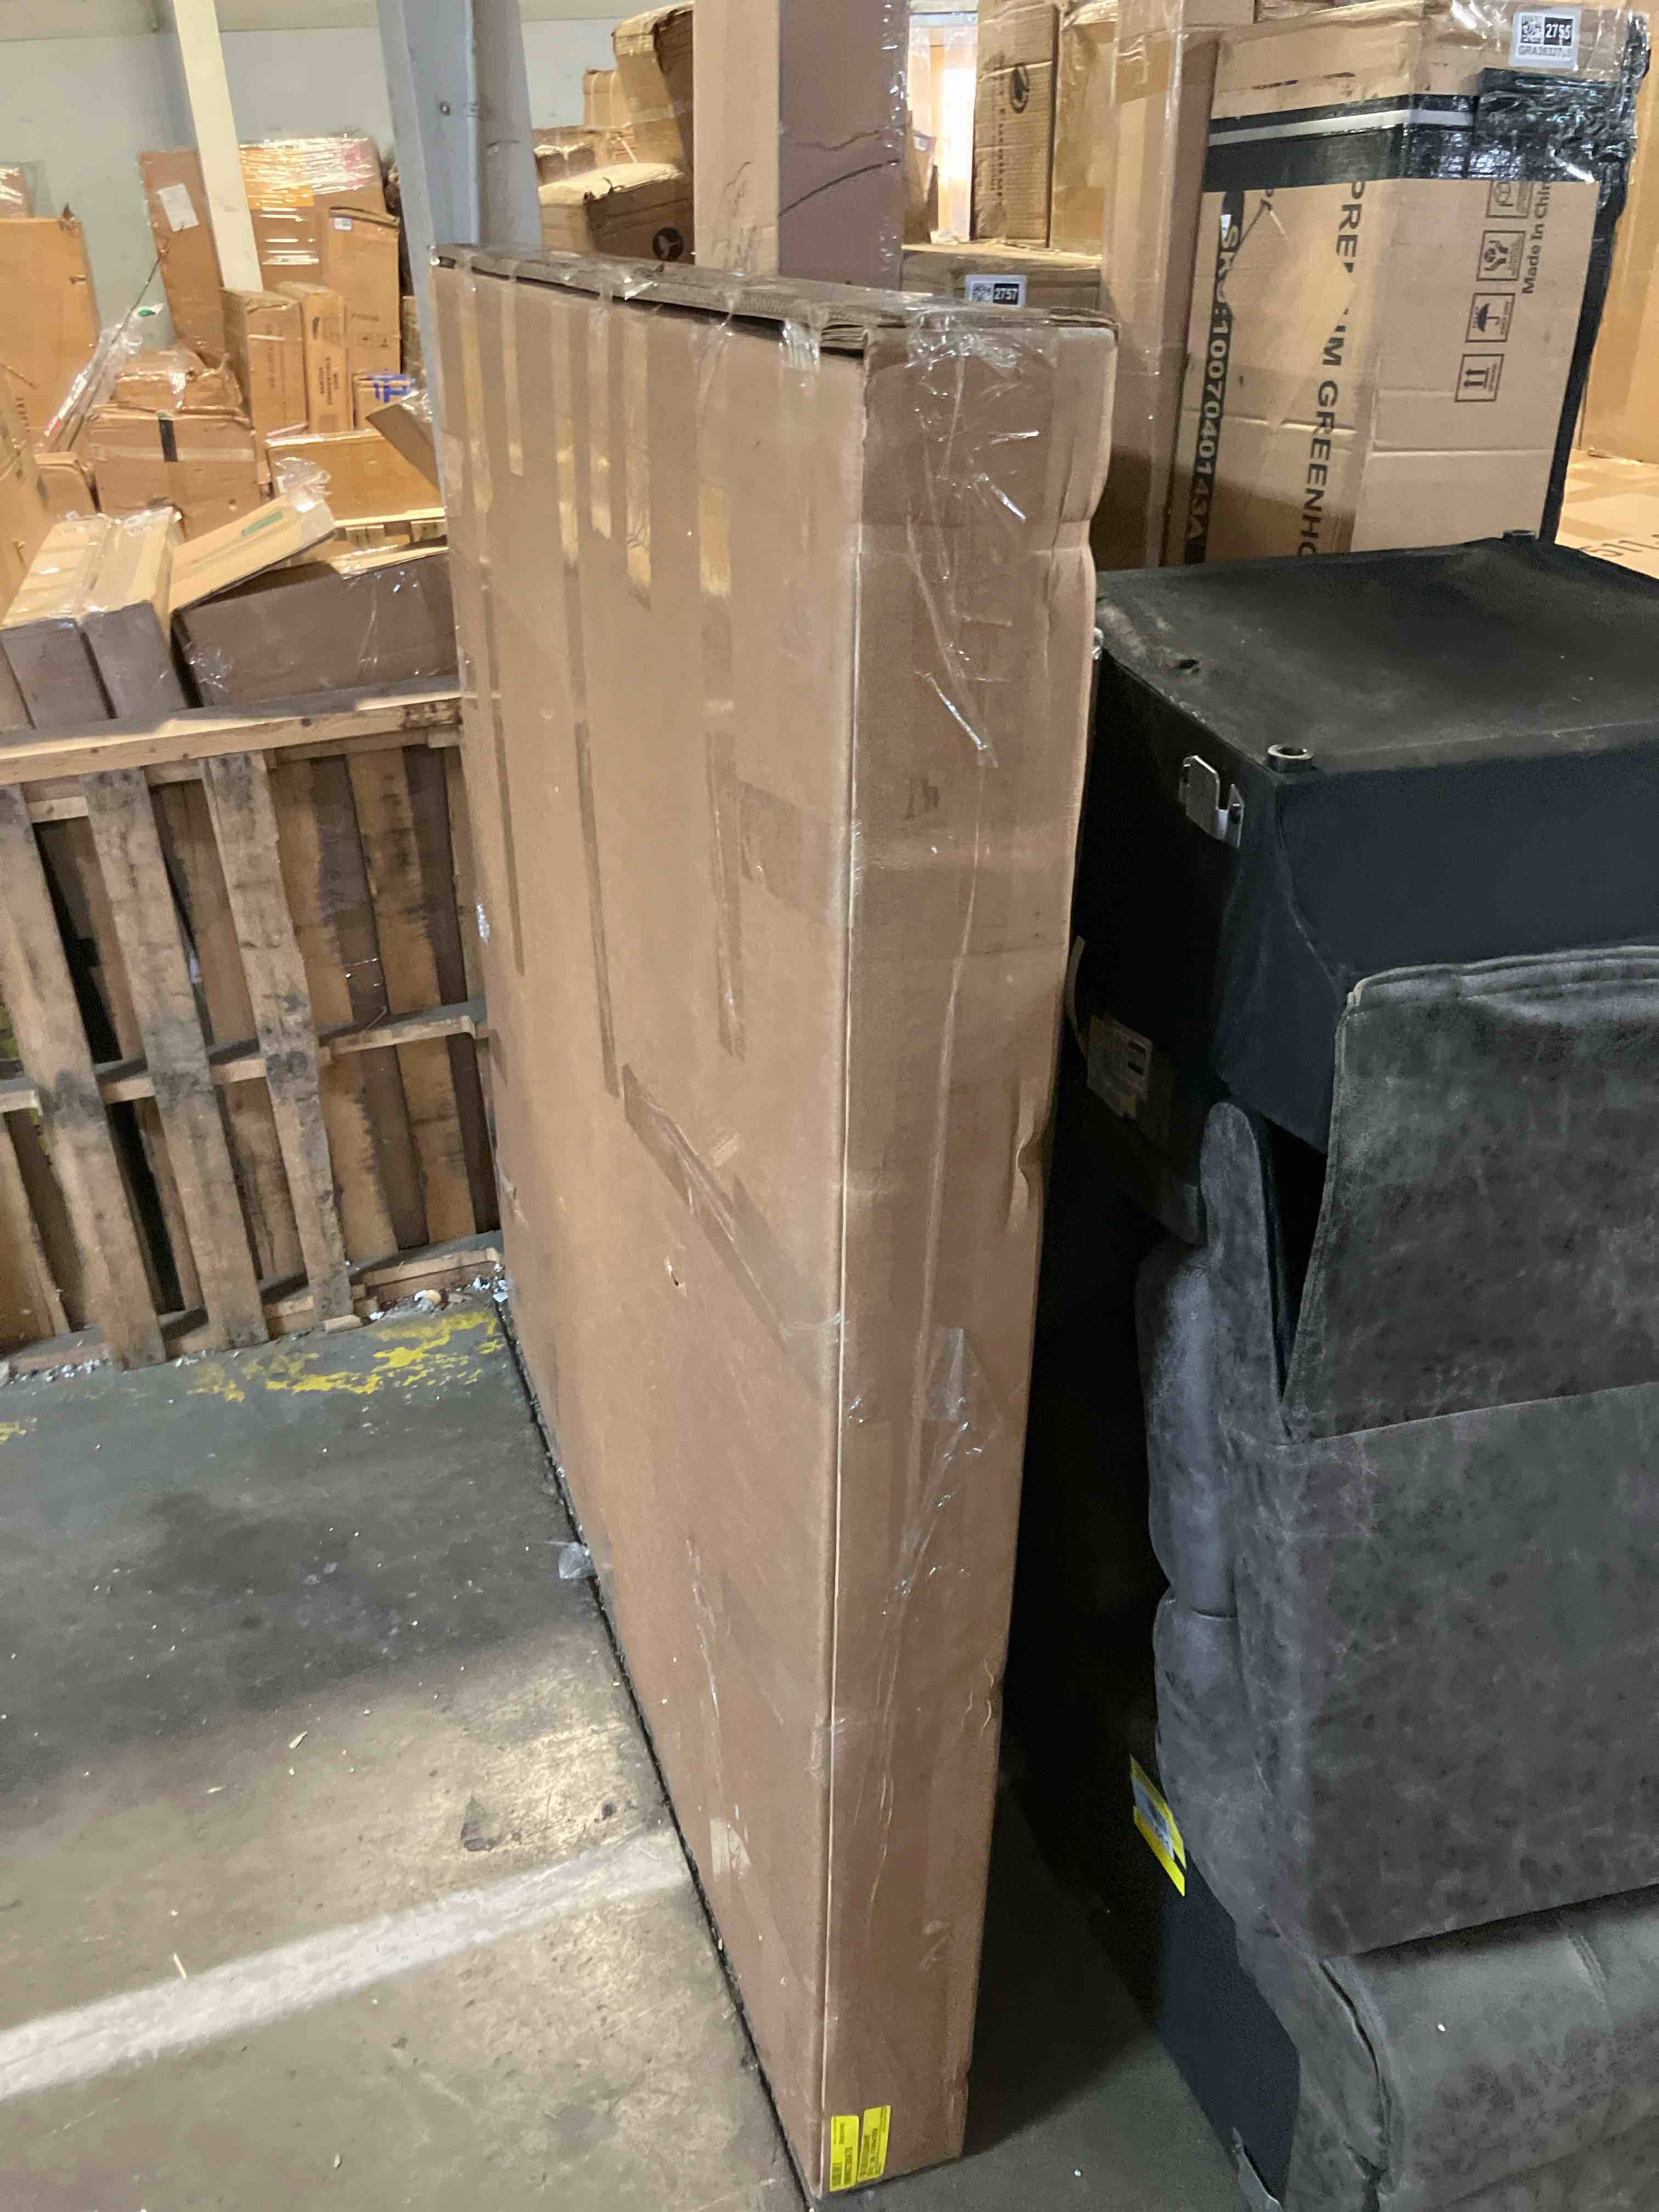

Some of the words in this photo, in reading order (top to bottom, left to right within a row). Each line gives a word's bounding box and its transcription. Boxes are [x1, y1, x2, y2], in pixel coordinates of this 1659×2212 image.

[1545, 23, 1571, 40] 2755
[1322, 181, 1366, 366] PREM
[1521, 245, 1541, 294] Made
[1531, 223, 1545, 240] In
[993, 287, 1019, 301] 2757
